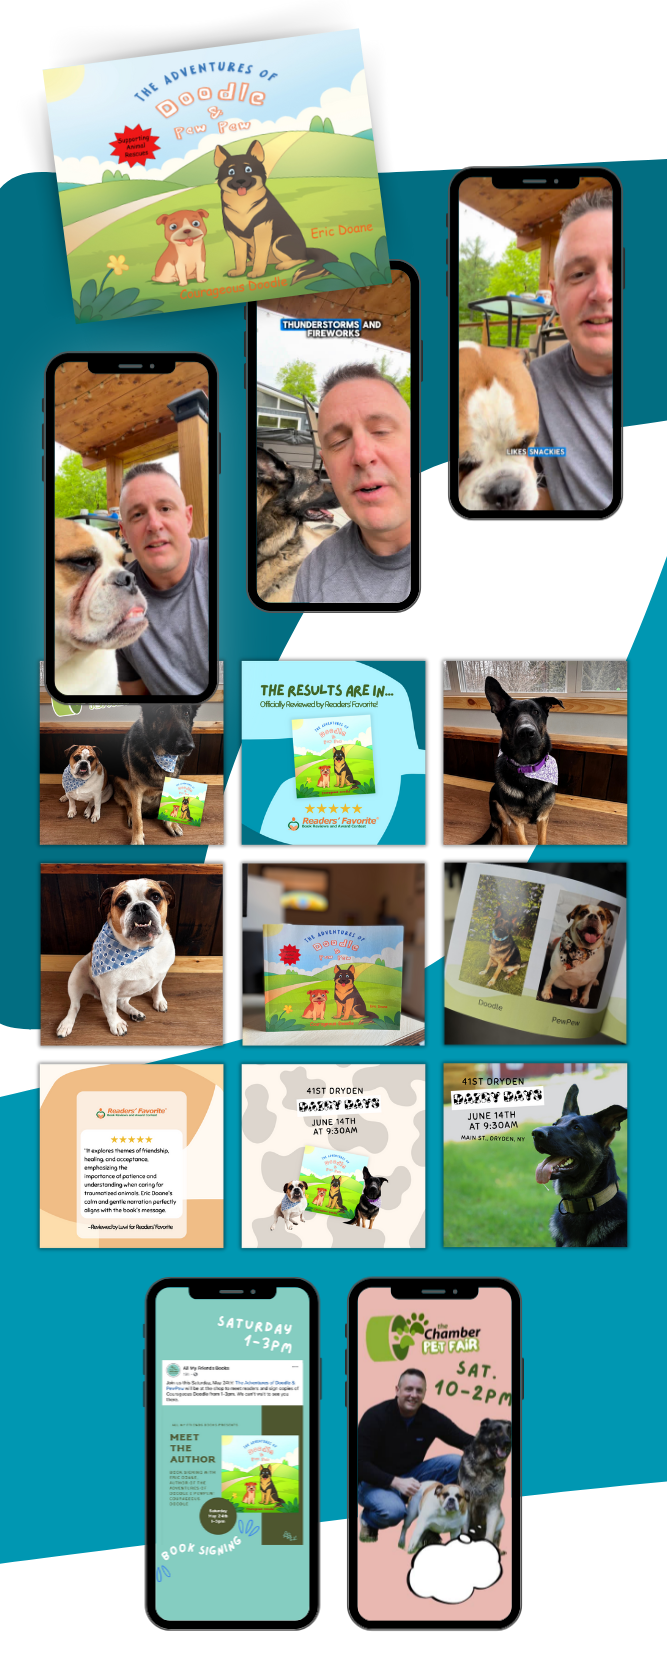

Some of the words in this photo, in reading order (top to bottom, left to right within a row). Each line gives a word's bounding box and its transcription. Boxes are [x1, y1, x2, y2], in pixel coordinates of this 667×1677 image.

[134, 82, 159, 102] THE
[163, 61, 253, 85] ADVENTURES
[259, 69, 278, 81] OF
[155, 82, 266, 119] Doodle
[207, 106, 223, 119] &
[117, 135, 150, 144] Supporting
[126, 142, 146, 150] Animal
[124, 150, 149, 158] Rescues
[310, 226, 335, 239] Eric
[338, 223, 374, 236] Doane
[179, 283, 245, 300] Courageous
[248, 276, 288, 292] Doodle
[261, 684, 284, 696] THE
[287, 684, 342, 698] RESULTS
[346, 684, 370, 698] ARE
[372, 685, 394, 698] IN...
[260, 700, 285, 709] Officially
[285, 700, 315, 708] Reviewed
[316, 700, 324, 709] by
[352, 700, 378, 708] Favorite!
[303, 934, 315, 942] THE
[317, 929, 356, 938] ADVENTURES
[312, 939, 359, 951] Doodle
[478, 999, 503, 1011] Doodle
[462, 1077, 484, 1086] 41ST
[486, 1077, 525, 1086] DRYDEN
[306, 1087, 326, 1095] 41ST
[329, 1087, 364, 1095] DRYDEN
[503, 1089, 542, 1102] DAYS
[344, 1098, 380, 1110] DAYS
[312, 1118, 333, 1126] JUNE
[336, 1117, 356, 1125] 14TH
[467, 1111, 491, 1120] JUNE
[326, 1126, 358, 1134] 9:30AM
[483, 1121, 518, 1129] 9:30AM
[217, 1316, 293, 1335] SATURDAY
[424, 1326, 481, 1340] Chamber
[244, 1334, 293, 1354] 1-3PM
[422, 1340, 446, 1355] PET
[456, 1360, 496, 1379] SAT.
[434, 1379, 512, 1406] 10-2PM
[170, 1433, 199, 1441] MEET
[170, 1444, 192, 1452] THE
[170, 1455, 216, 1463] AUTHOR
[161, 1543, 196, 1560] BOOK
[198, 1536, 242, 1555] SIGNING
